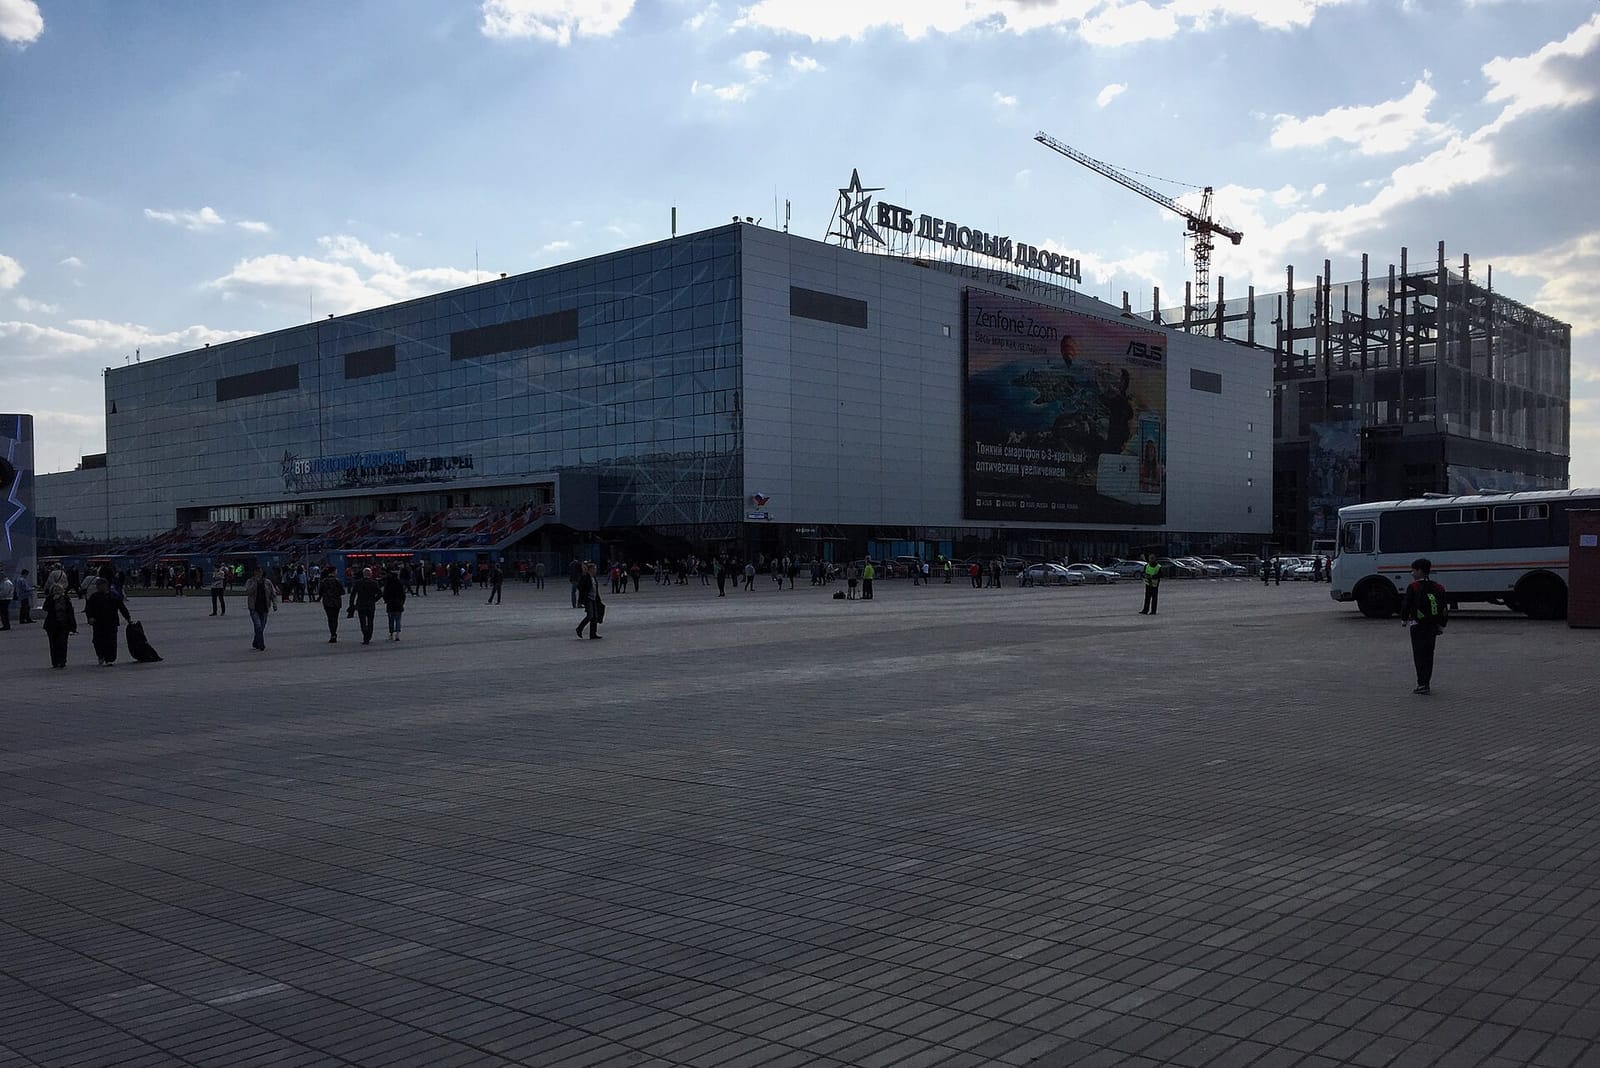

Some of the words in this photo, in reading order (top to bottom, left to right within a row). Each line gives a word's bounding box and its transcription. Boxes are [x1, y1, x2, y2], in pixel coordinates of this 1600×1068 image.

[877, 201, 913, 232] ВТБ
[918, 214, 1013, 263] ЛЕДОВЫЙ
[1014, 242, 1082, 283] ДВОРЕЦ
[976, 306, 1024, 334] Zenfone
[1027, 318, 1057, 341] Zoom
[1126, 340, 1162, 362] ASUS
[976, 441, 1002, 456] Тонкий
[1004, 446, 1040, 461] смартфон
[294, 459, 311, 474] ВТБ
